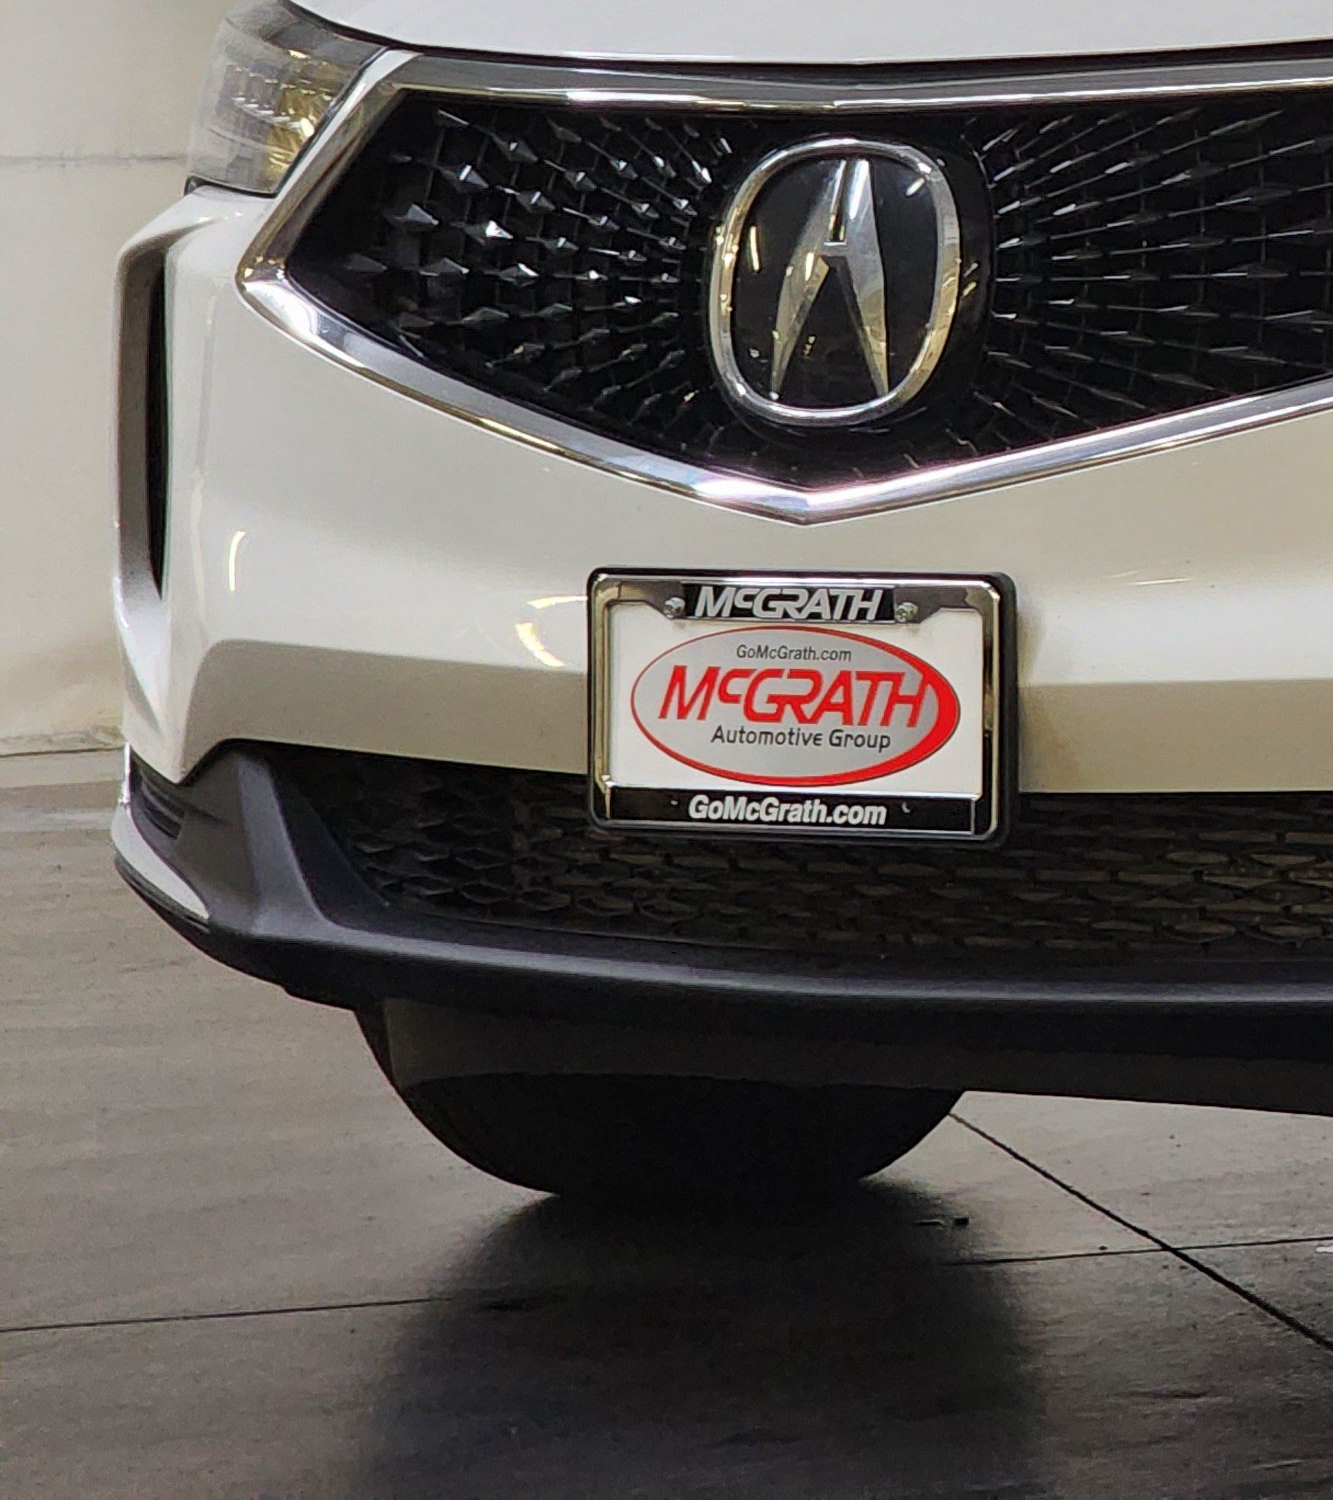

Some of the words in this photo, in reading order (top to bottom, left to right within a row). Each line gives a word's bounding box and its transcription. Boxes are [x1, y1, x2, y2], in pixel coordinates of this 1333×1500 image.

[736, 644, 852, 662] GoMcGrath.com
[711, 725, 823, 747] Automotive
[828, 728, 891, 753] Group
[688, 794, 888, 825] GoMcGrath.com
